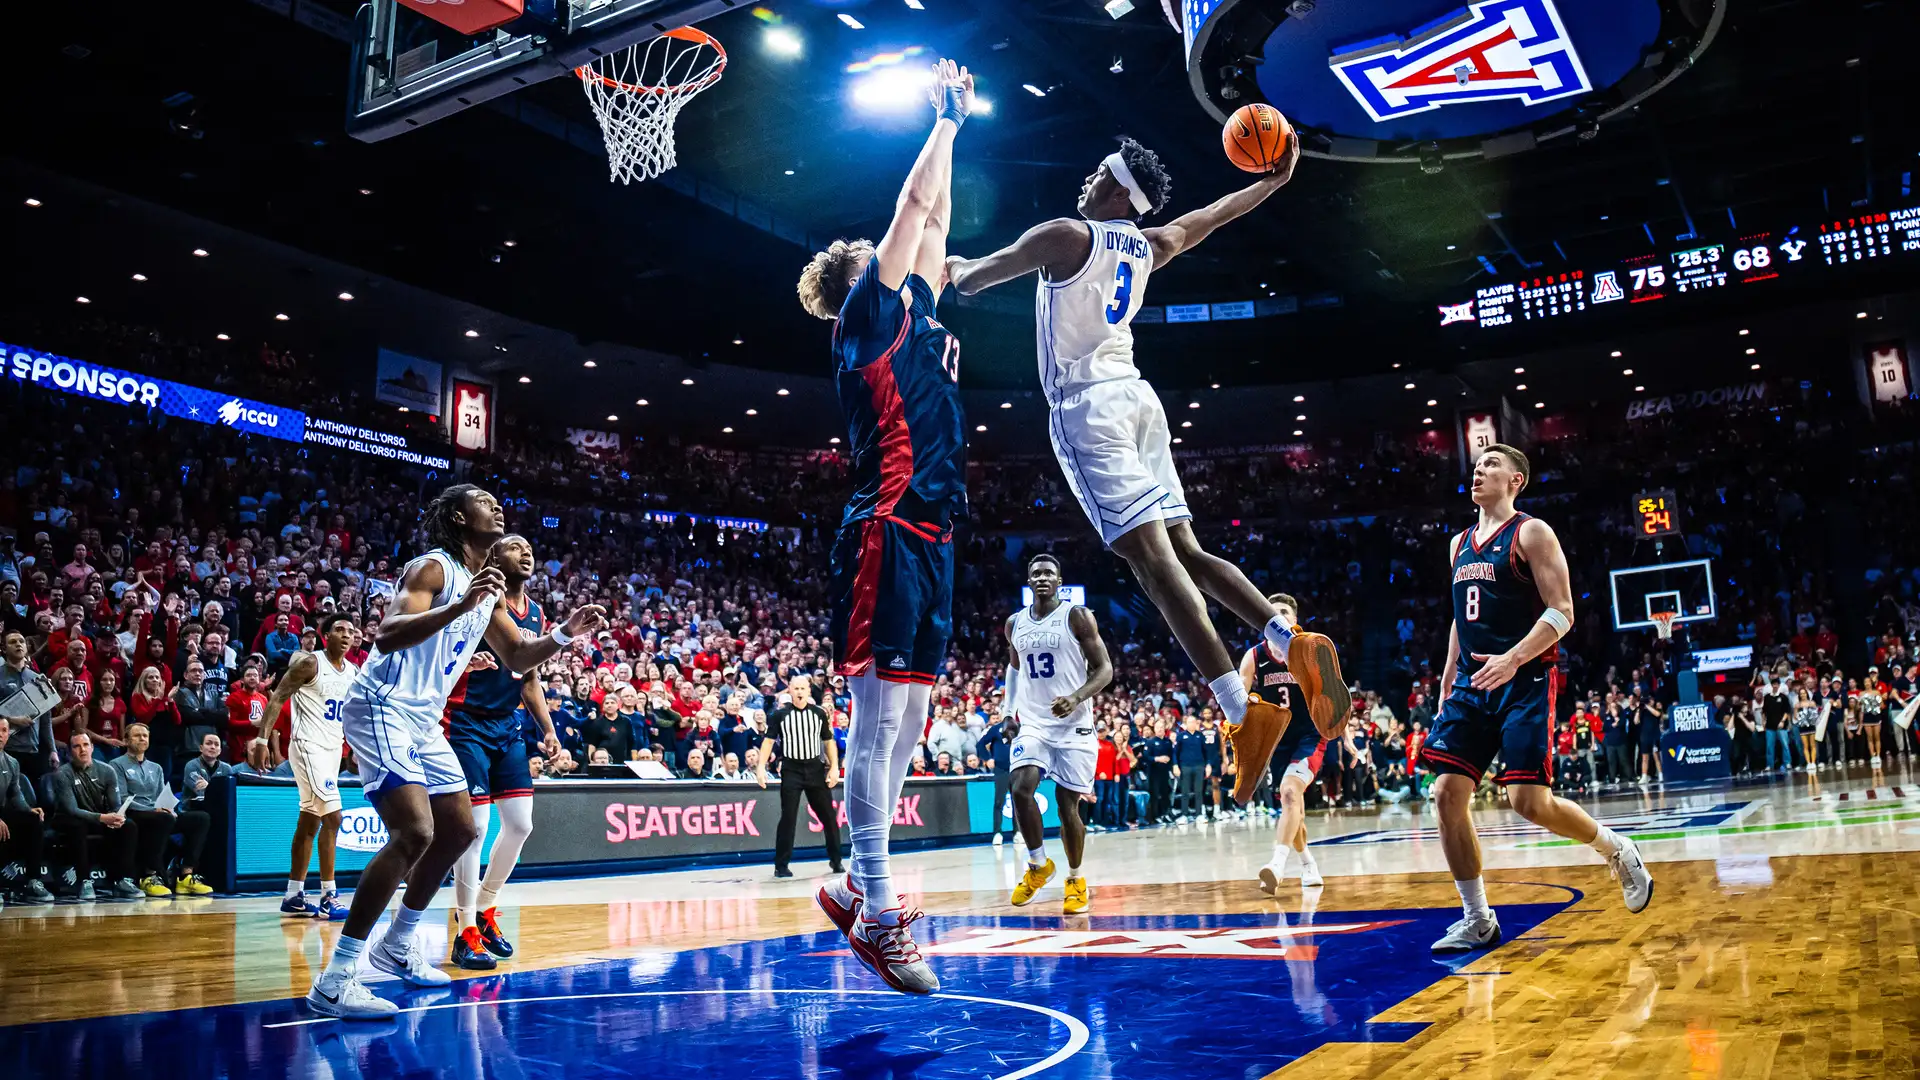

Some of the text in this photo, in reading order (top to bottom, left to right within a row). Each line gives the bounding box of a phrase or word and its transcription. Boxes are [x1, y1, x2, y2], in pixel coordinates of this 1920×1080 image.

[1819, 234, 1832, 244] 13
[1833, 231, 1846, 242] 33
[1850, 229, 1857, 238] 4
[1876, 223, 1889, 234] 10
[1894, 218, 1920, 231] POIN
[1823, 245, 1831, 254] 3
[1852, 240, 1860, 249] 2
[1866, 237, 1874, 246] 9
[1881, 234, 1889, 244] 2
[1840, 253, 1847, 263] 2
[1854, 250, 1862, 260] 0
[1868, 248, 1876, 257] 2
[1883, 245, 1891, 255] 3
[1678, 247, 1720, 268] 25.3
[1733, 246, 1771, 271] 68
[1629, 265, 1666, 291] 75
[1105, 261, 1133, 325] 3
[1477, 284, 1515, 299] PLAYER
[1478, 294, 1515, 308] POINTS
[1519, 290, 1532, 300] 12
[1532, 288, 1545, 298] 22
[1545, 285, 1558, 295] 11
[1522, 300, 1530, 310] 3
[1535, 298, 1543, 307] 4
[1549, 296, 1557, 305] 2
[1576, 291, 1583, 300] 7
[1480, 314, 1513, 328] FOULS
[1550, 306, 1558, 316] 2
[1563, 304, 1572, 313] 0
[1577, 301, 1585, 311] 3
[942, 333, 960, 383] 13
[11, 352, 160, 408] SPONSOR
[1881, 369, 1896, 384] 10
[1691, 381, 1766, 408] DOWN
[240, 406, 278, 428] ICCU
[464, 413, 481, 430] 34
[305, 416, 408, 448] 3, ANTHONY DELL'ORSO.
[1476, 435, 1490, 448] 31
[303, 430, 450, 470] ANTHONY DELL'ORSO FROM JADEN
[1644, 510, 1671, 534] 24
[1453, 562, 1497, 585] ARIZONA
[1466, 585, 1480, 622] 8
[1016, 631, 1061, 652] BYU
[1026, 652, 1055, 679] 13
[1278, 686, 1290, 708] 3
[1675, 718, 1709, 732] PROTEIN
[1685, 755, 1707, 764] West
[1686, 747, 1721, 757] Vantage
[605, 799, 760, 843] SEATGEEK
